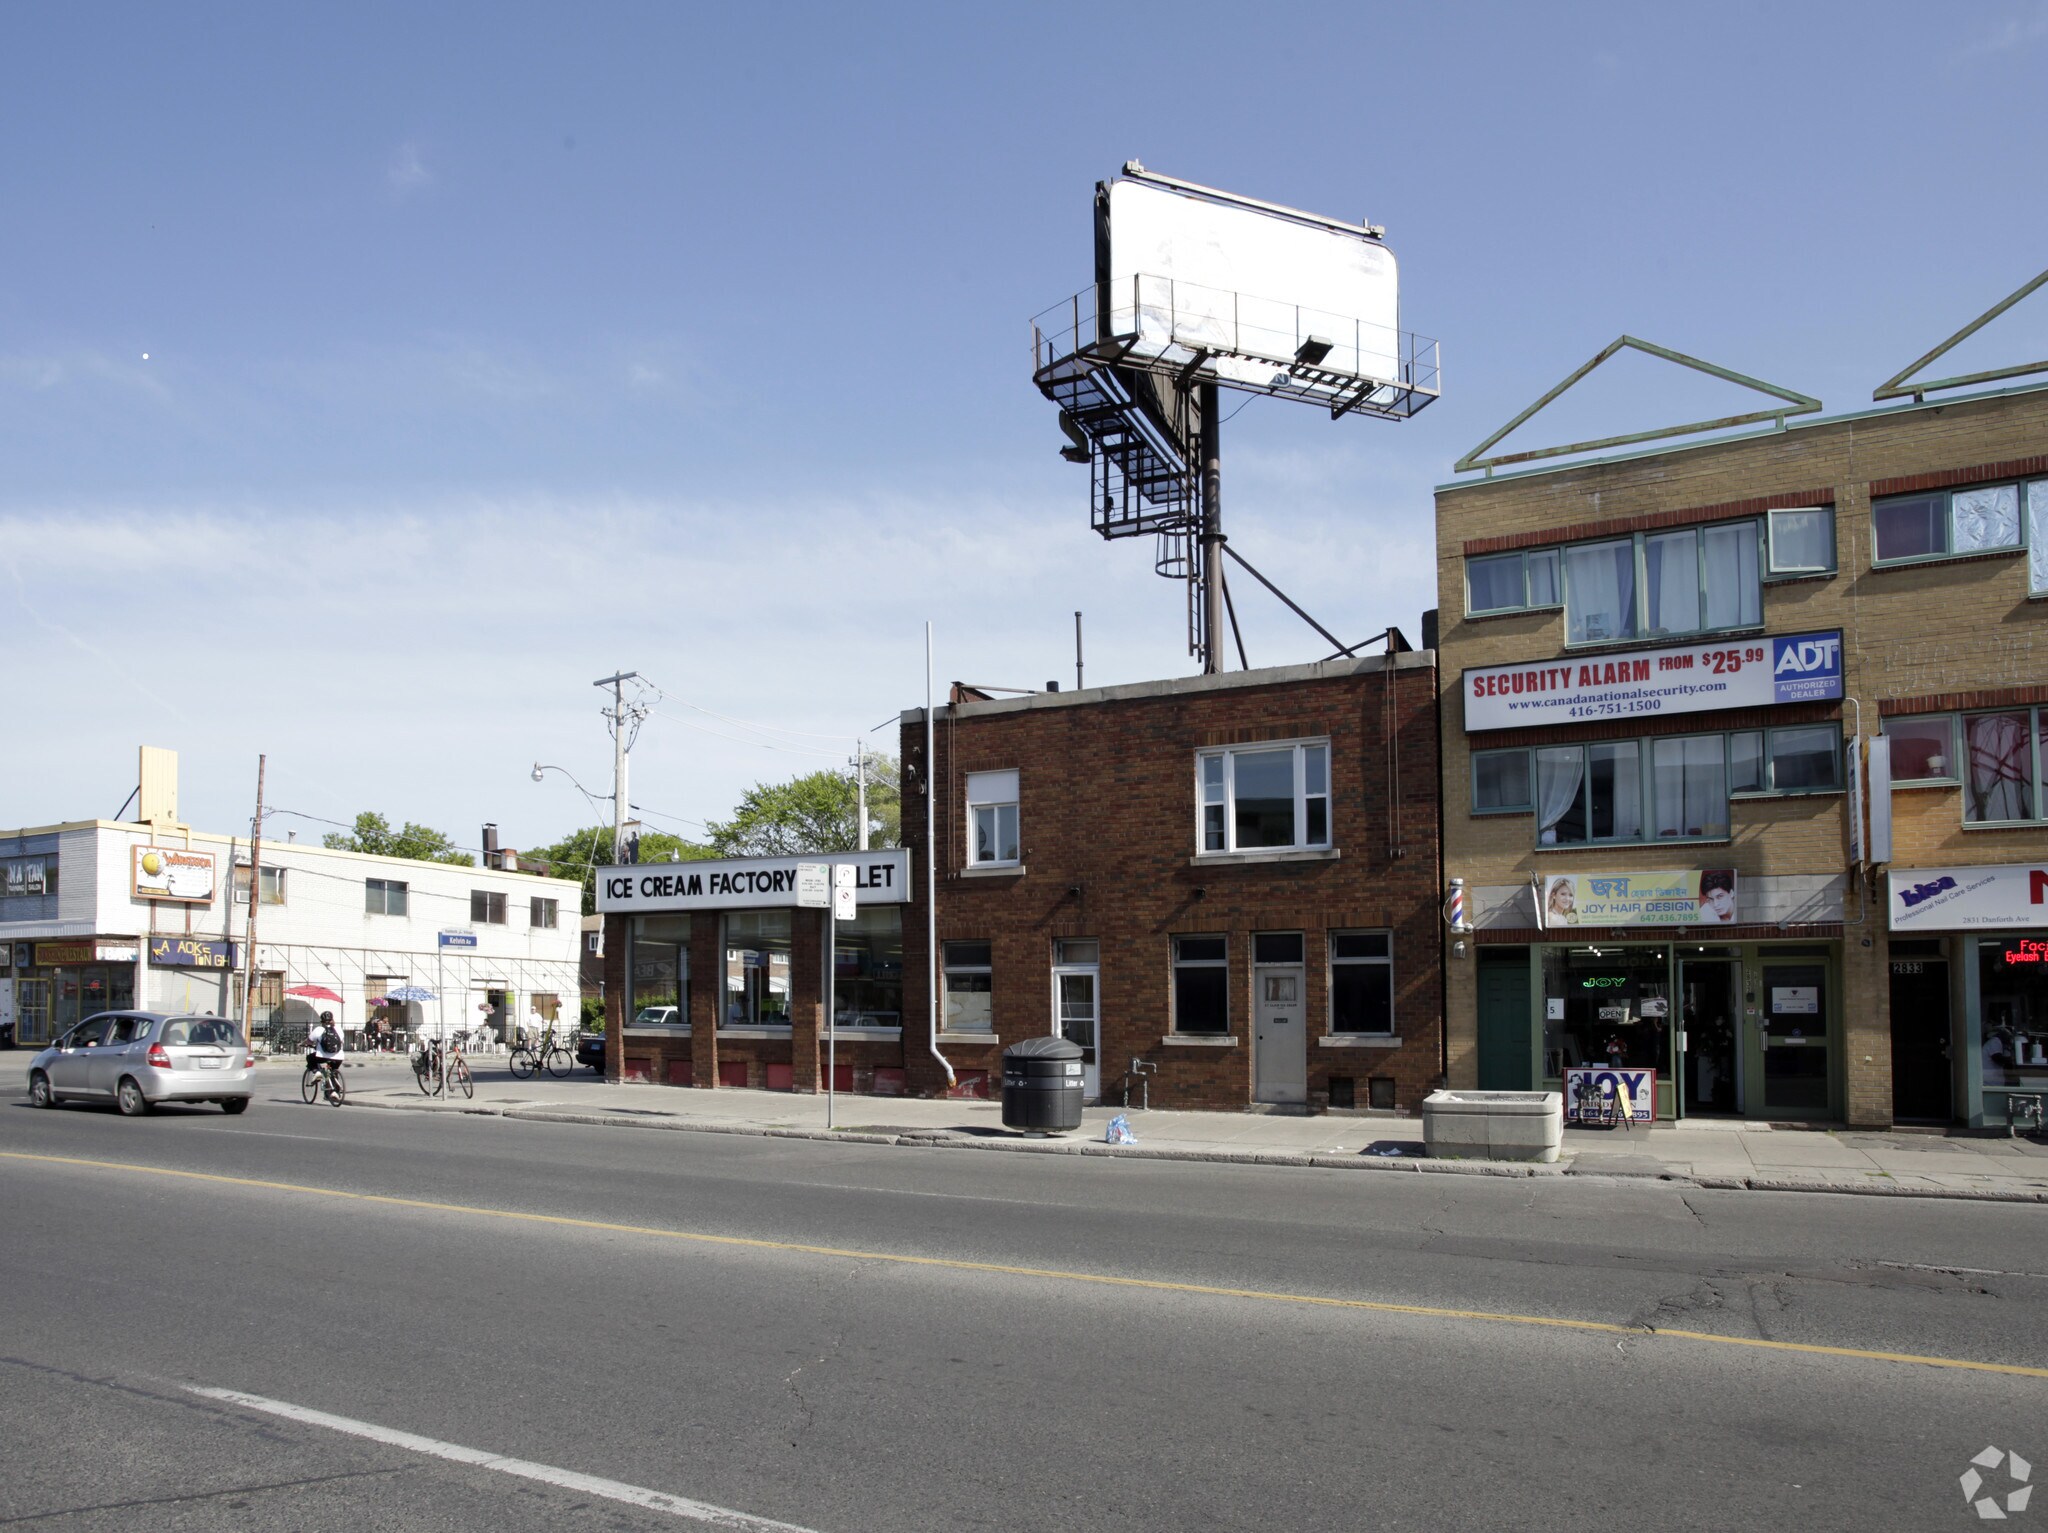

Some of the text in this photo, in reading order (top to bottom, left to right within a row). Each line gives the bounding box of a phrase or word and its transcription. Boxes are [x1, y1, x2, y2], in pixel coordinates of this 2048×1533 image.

[1774, 639, 1839, 675] ADT
[1473, 648, 1764, 698] SECURITY ALARM FROM $25.99
[1780, 680, 1836, 692] AUTHORIZED
[1508, 682, 1727, 710] www.canadanationalsecurity.com
[1790, 689, 1826, 699] DEALER
[1569, 699, 1661, 717] 416-751-1500
[606, 878, 632, 899] ICE
[640, 872, 702, 897] CREAM
[709, 868, 797, 894] FACTORY
[1894, 875, 1996, 924] Professional Nail Care Services
[1582, 901, 1694, 913] JOY HAIR DESIGN
[1640, 913, 1699, 922] 647.436.7895
[1962, 916, 1979, 924] 2831
[1981, 915, 2014, 923] Danforth
[449, 936, 465, 945] Kelvin
[2005, 951, 2040, 964] Eyelash
[1895, 963, 1922, 973] 2833
[1583, 977, 1626, 987] JOY
[1599, 1009, 1621, 1019] OPEN
[1065, 1079, 1078, 1087] Litter
